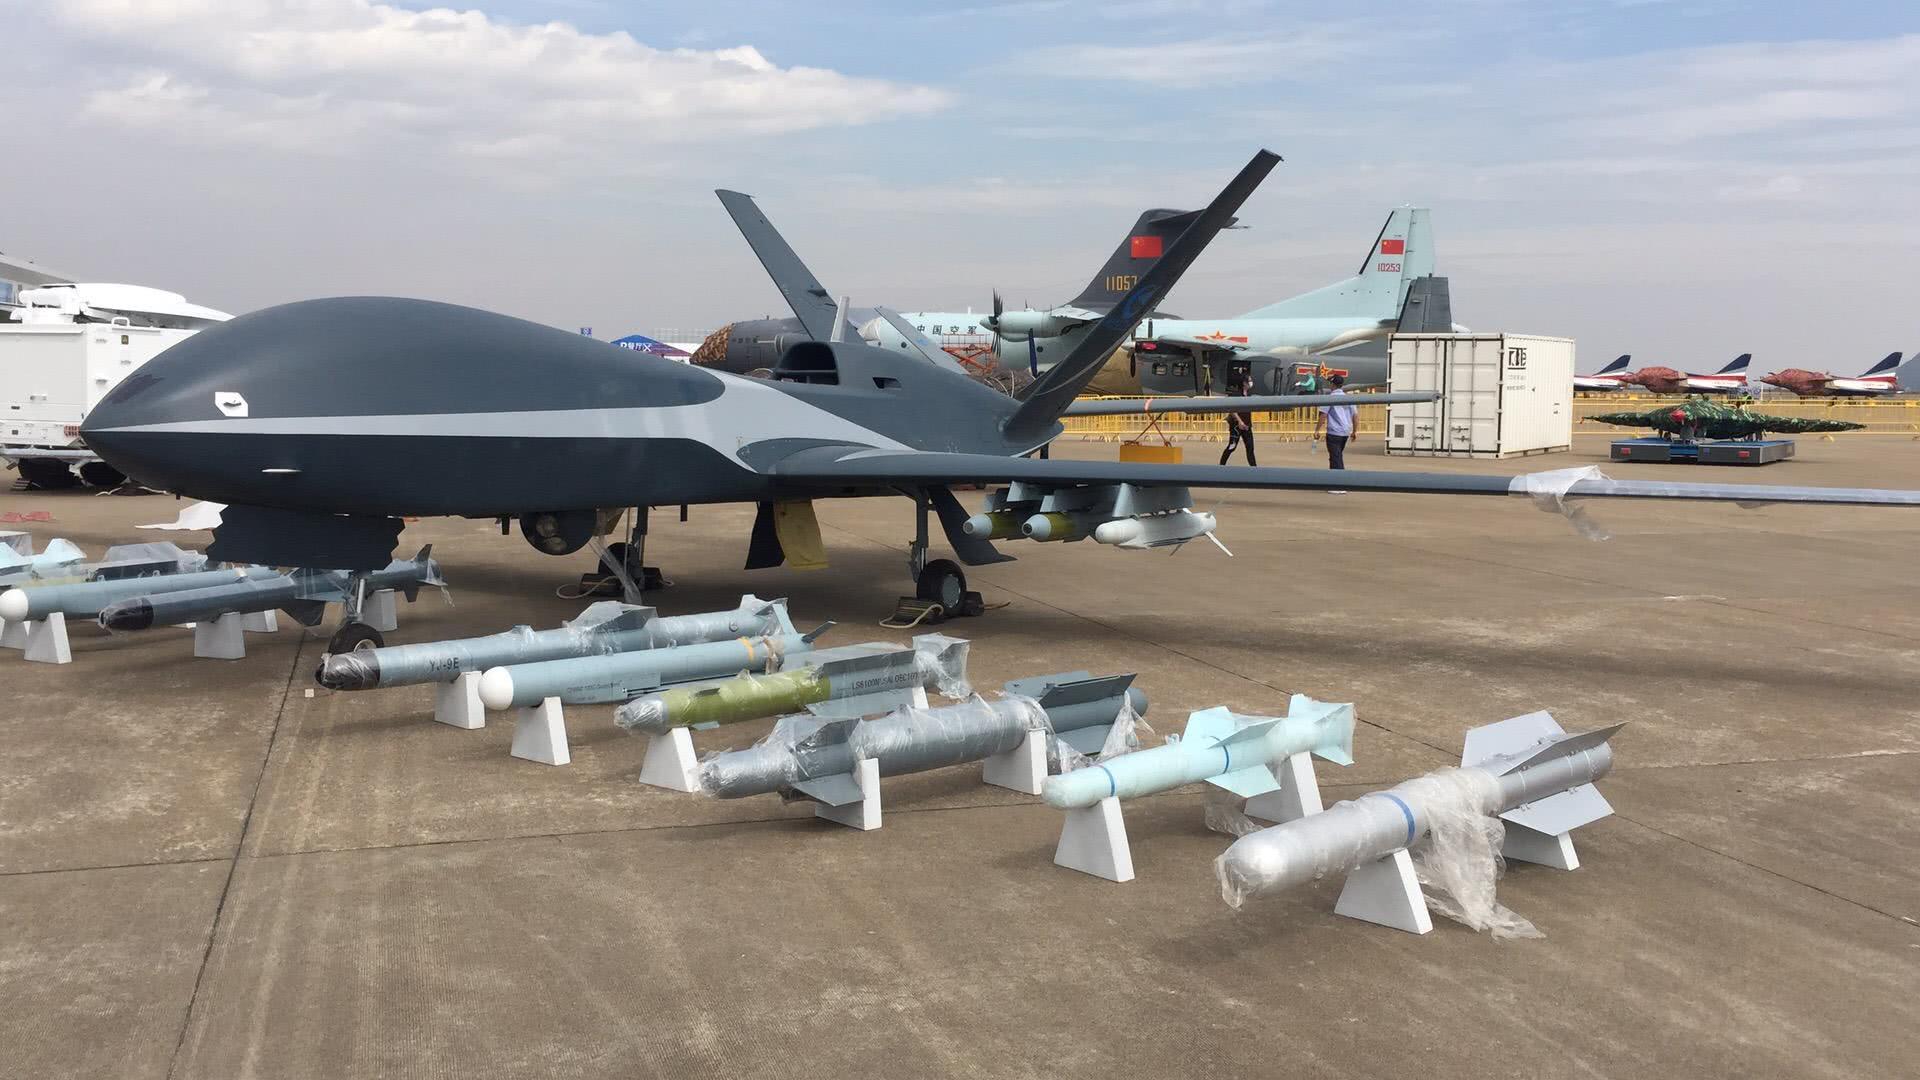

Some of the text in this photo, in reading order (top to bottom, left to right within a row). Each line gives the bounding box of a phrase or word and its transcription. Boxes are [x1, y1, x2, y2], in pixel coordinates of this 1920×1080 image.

[1377, 263, 1401, 272] 10253
[1106, 275, 1138, 291] 11057
[917, 324, 977, 336] 中国空军
[429, 657, 460, 672] YJ-9E
